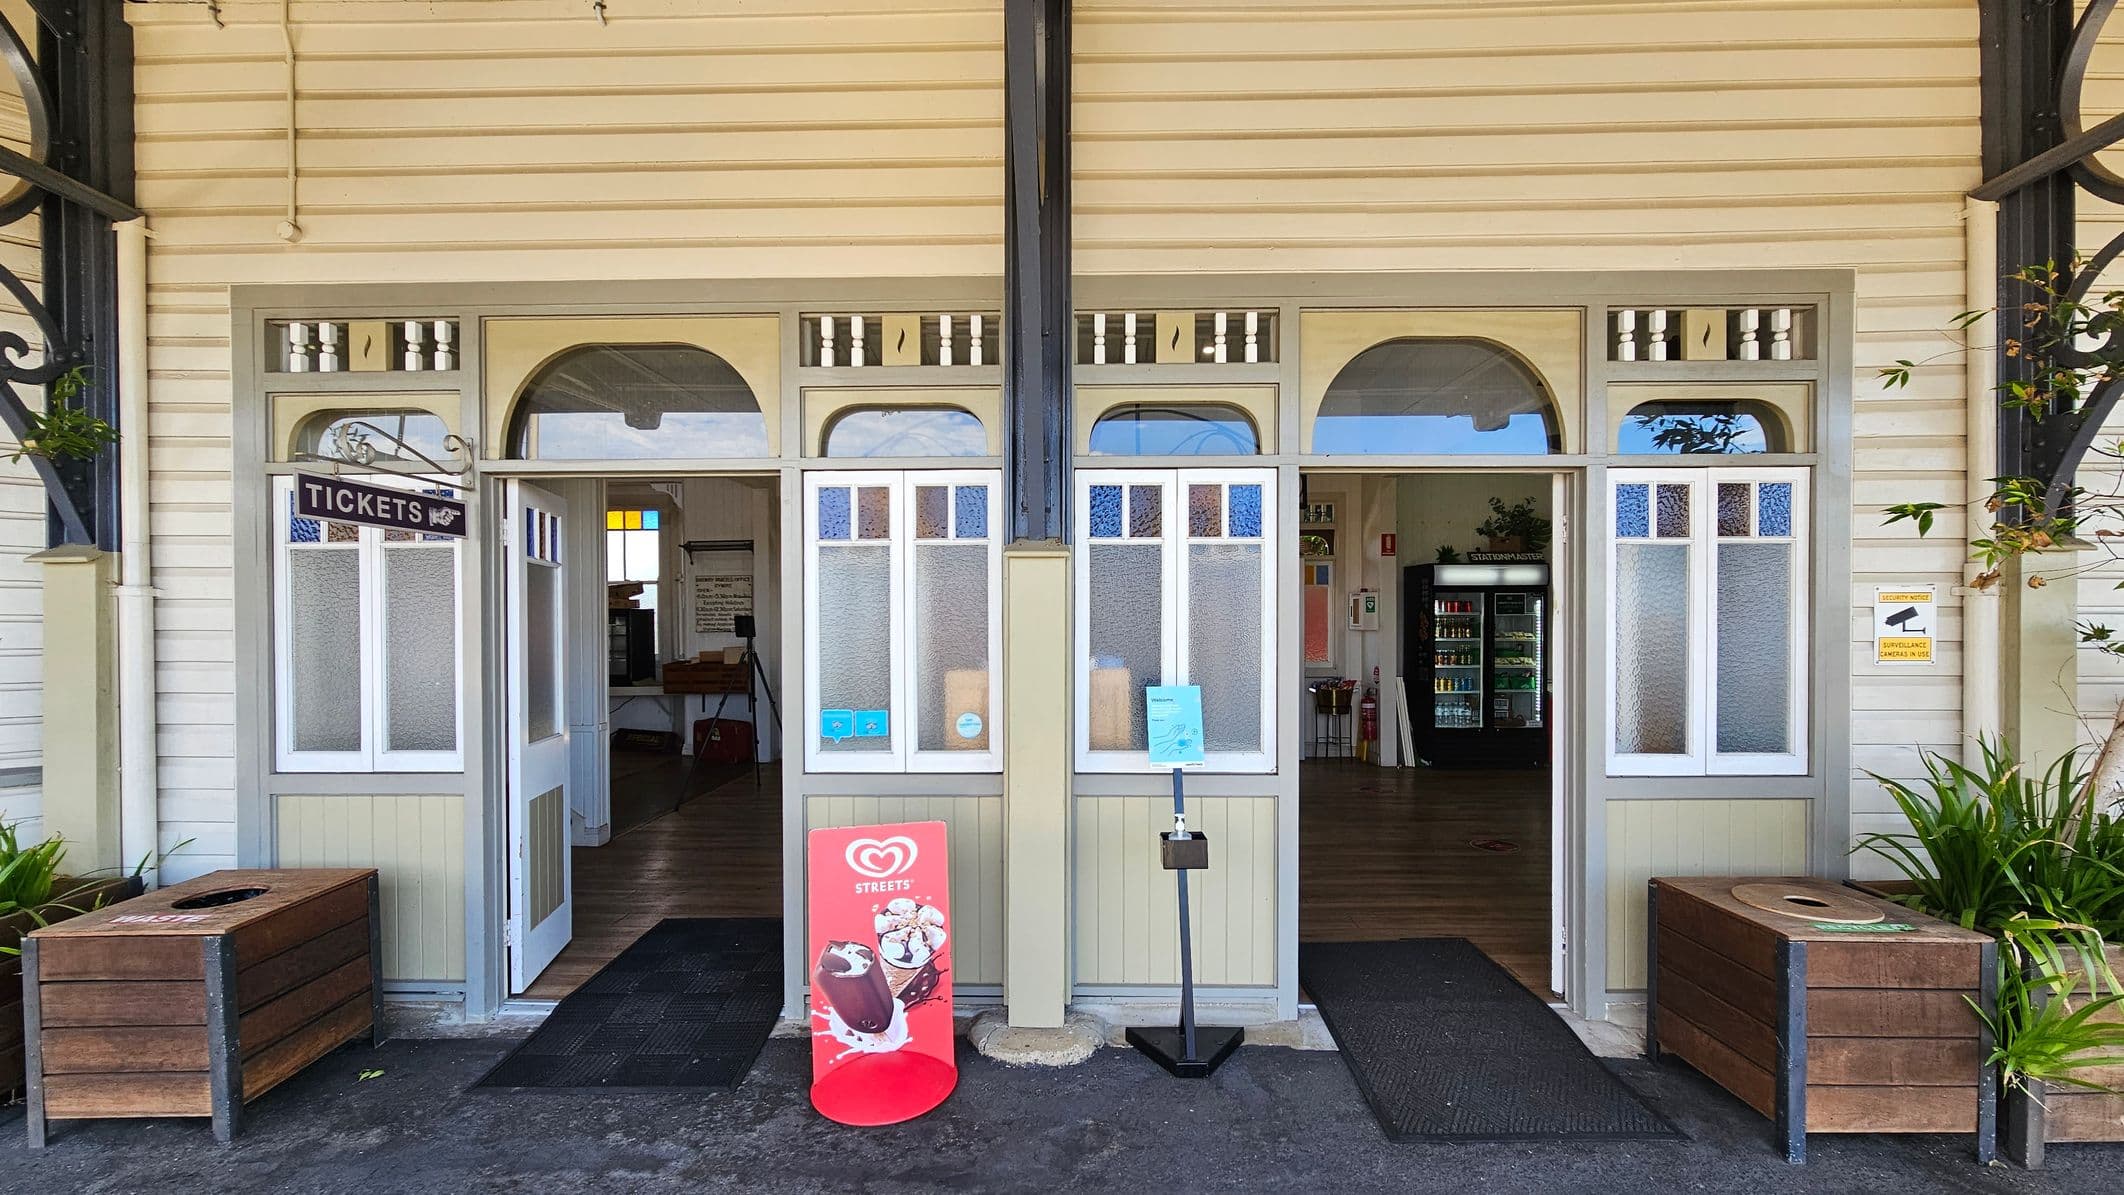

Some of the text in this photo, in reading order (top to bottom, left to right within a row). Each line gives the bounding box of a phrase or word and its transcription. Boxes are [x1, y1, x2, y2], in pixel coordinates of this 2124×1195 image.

[305, 483, 422, 523] TICKETS
[1471, 553, 1544, 561] STATIONMASTER
[855, 880, 910, 894] STREETS
[109, 915, 211, 923] WASTE
